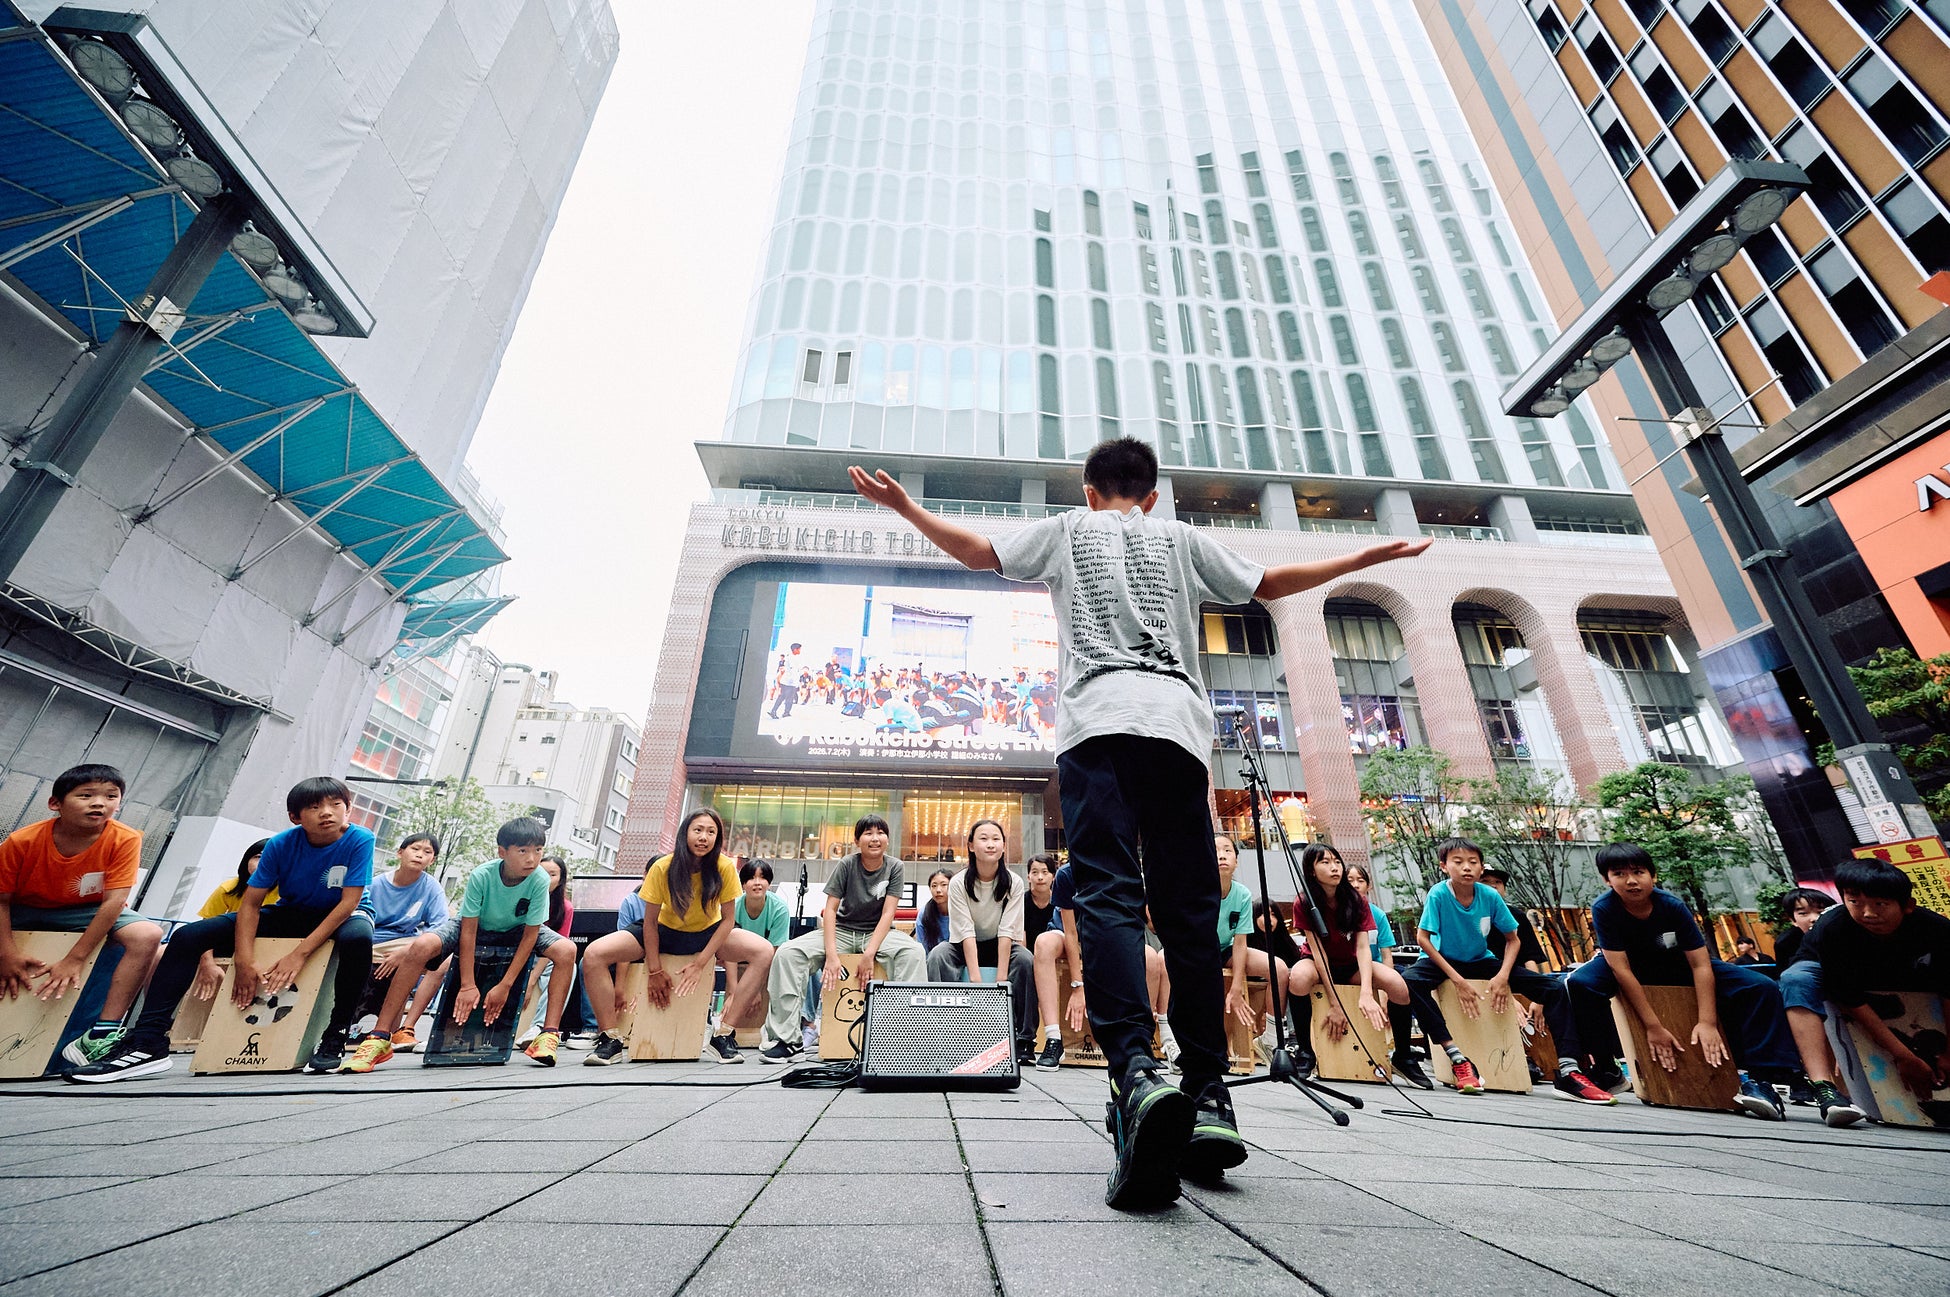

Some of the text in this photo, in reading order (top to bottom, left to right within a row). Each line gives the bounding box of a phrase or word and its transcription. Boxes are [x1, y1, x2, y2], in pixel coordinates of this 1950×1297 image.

[728, 508, 785, 520] TOKYU
[721, 524, 875, 550] KABUKICHO
[1138, 597, 1165, 605] Yazawa
[1138, 605, 1166, 613] Waseda
[1140, 618, 1168, 630] oup
[910, 995, 972, 1007] CUBE
[224, 1057, 268, 1066] CHAANY
[1074, 1053, 1102, 1061] CHAANY
